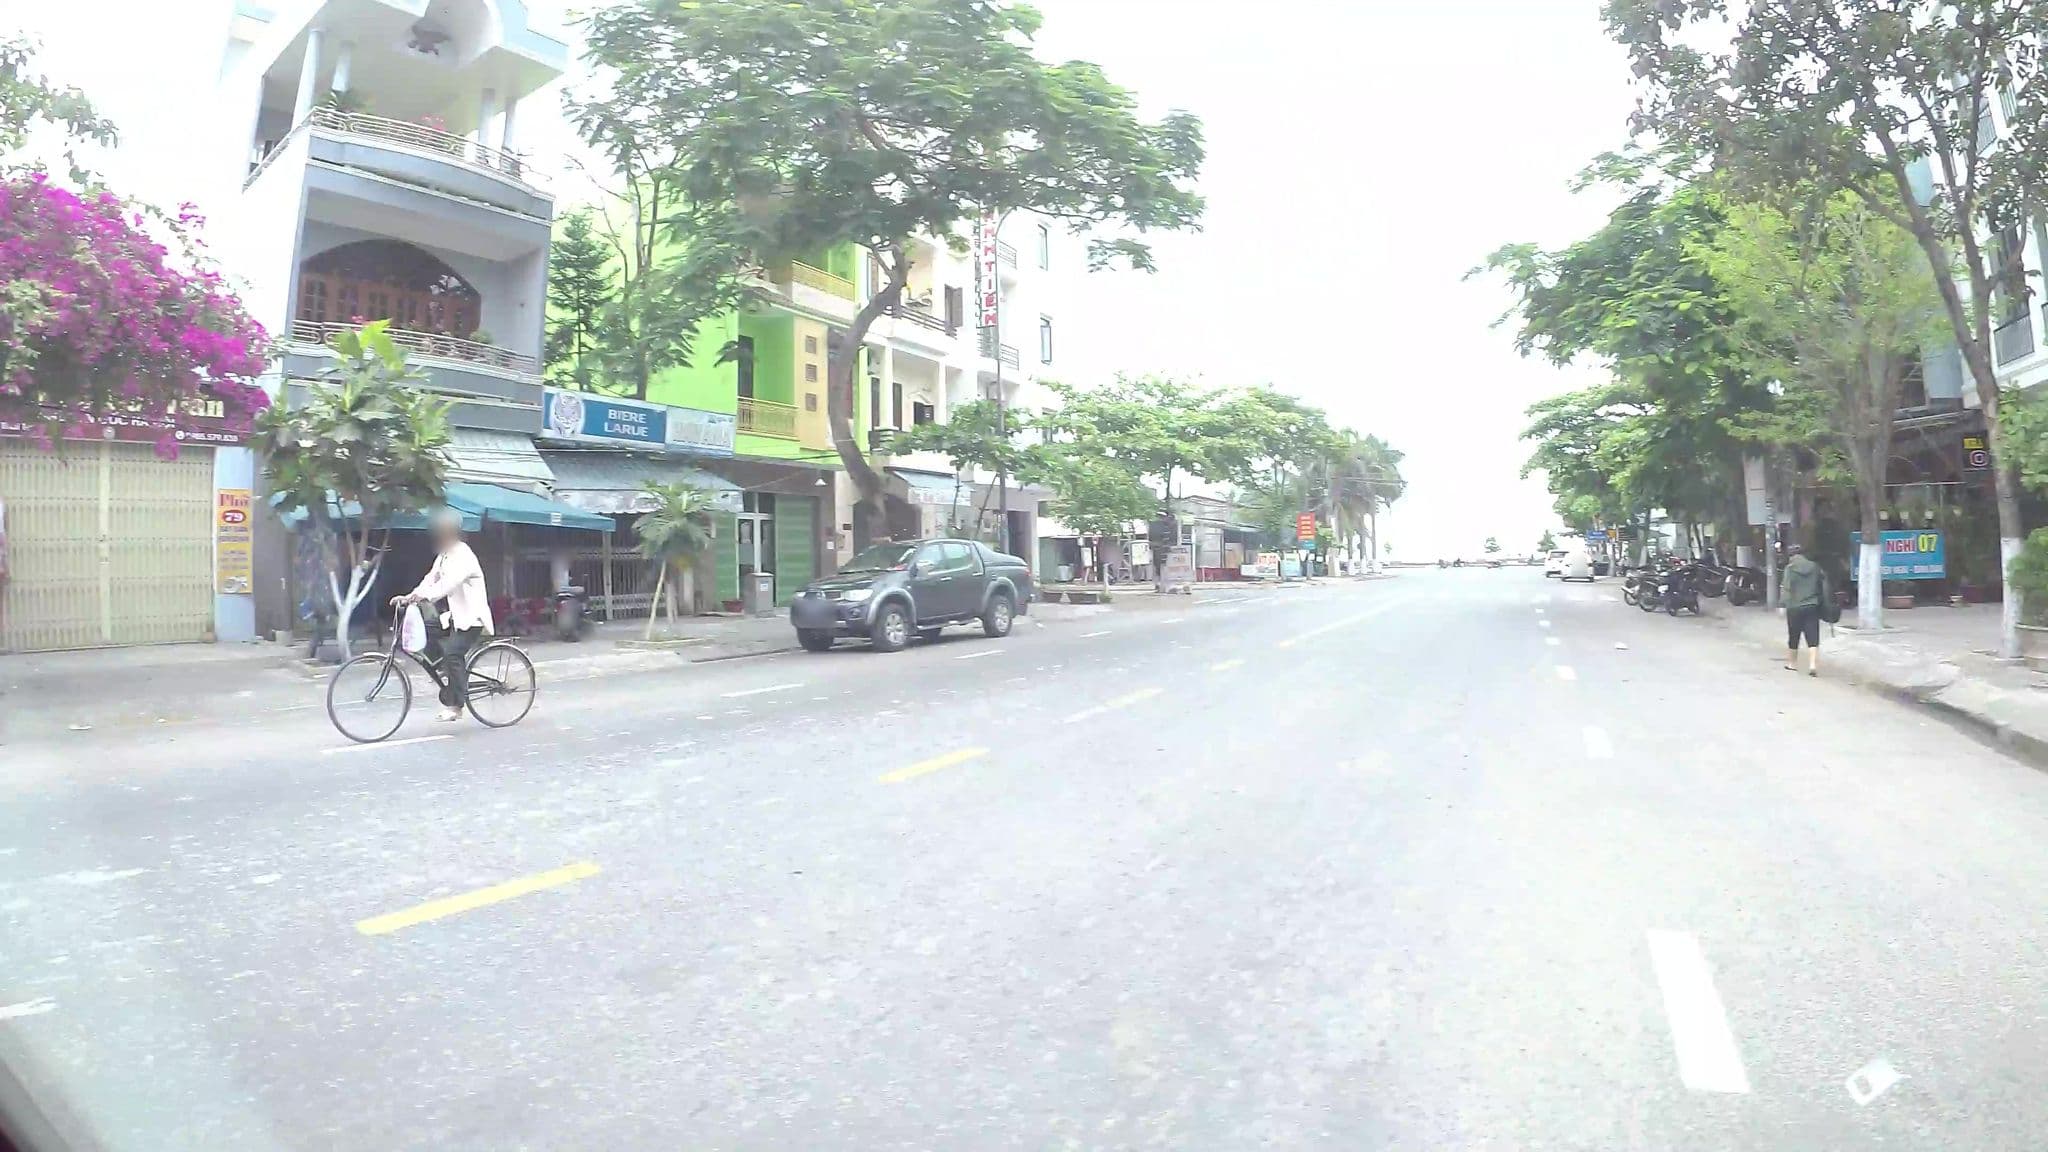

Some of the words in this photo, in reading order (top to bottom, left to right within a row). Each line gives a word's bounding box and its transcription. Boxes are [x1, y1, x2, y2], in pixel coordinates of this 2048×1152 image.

[608, 409, 647, 424] BIERE
[604, 422, 649, 437] LARUE
[224, 512, 244, 522] 79
[1918, 533, 1939, 552] 07
